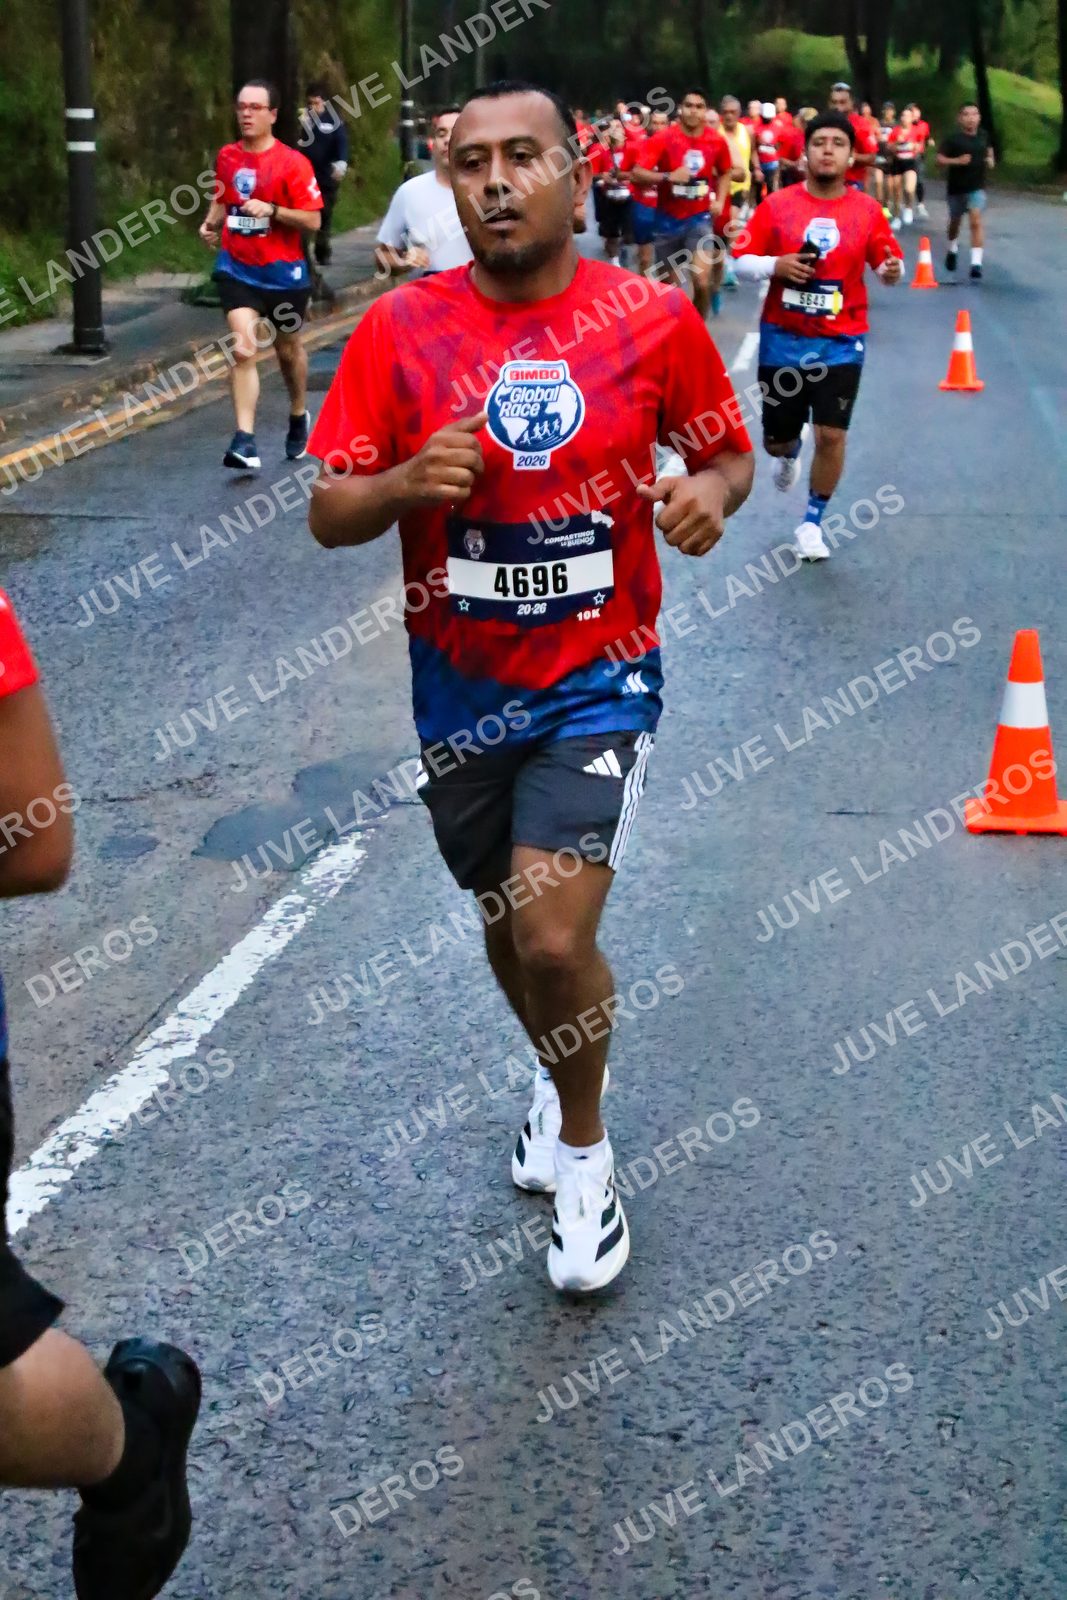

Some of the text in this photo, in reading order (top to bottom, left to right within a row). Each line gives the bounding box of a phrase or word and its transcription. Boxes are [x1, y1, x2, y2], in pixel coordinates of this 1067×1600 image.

[509, 369, 560, 381] BIMBO
[510, 385, 560, 403] Global
[499, 401, 540, 417] Race
[517, 455, 547, 467] 2026
[494, 562, 568, 598] 4696
[577, 608, 601, 621] 10K
